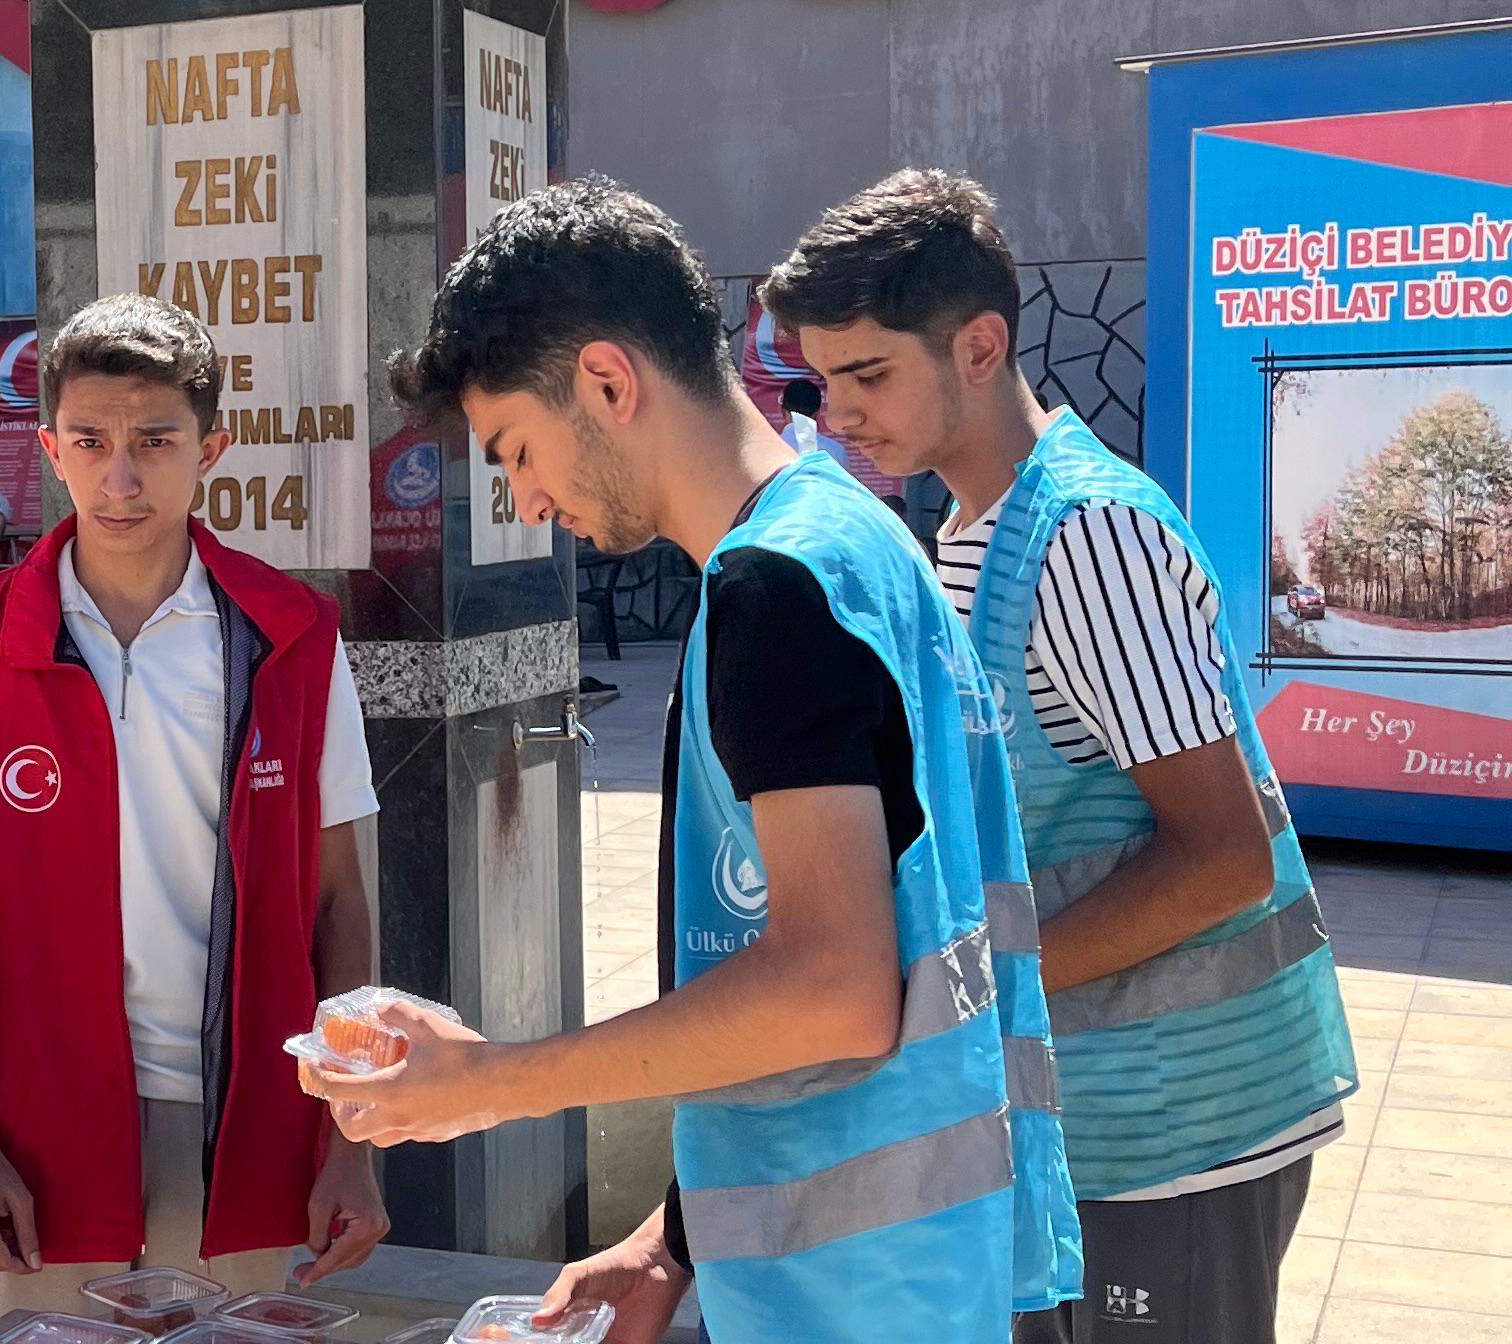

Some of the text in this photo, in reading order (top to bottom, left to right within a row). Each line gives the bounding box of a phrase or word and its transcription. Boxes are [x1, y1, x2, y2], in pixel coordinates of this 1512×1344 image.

[145, 47, 301, 127] NAFTA
[479, 47, 533, 124] NAFTA
[1214, 215, 1512, 277] DÜZİÇİ BELEDİY
[139, 254, 323, 326] KAYBET
[1217, 273, 1512, 325] TAHSİLAT BÜRO
[215, 404, 355, 445] UMLARI
[1300, 707, 1416, 744] Her Şey
[686, 925, 736, 953] Ülkü
